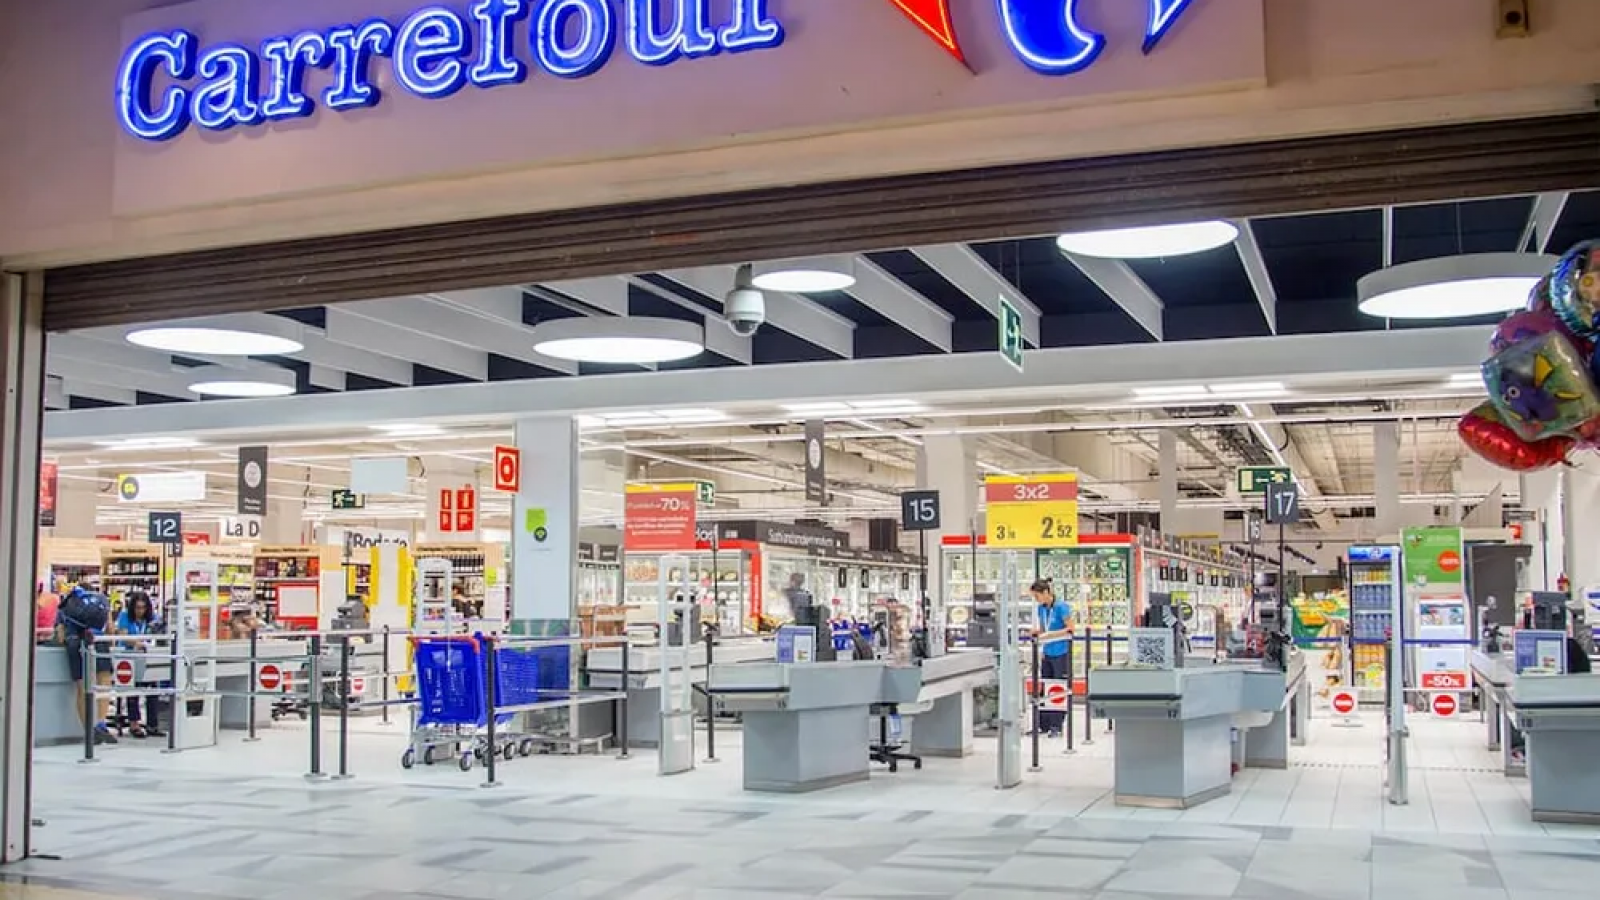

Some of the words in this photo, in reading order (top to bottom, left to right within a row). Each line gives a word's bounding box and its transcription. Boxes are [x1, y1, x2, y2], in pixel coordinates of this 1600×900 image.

[1013, 483, 1049, 499] 3x2
[909, 498, 936, 522] 15
[1274, 491, 1296, 515] 17
[153, 518, 177, 537] 12
[226, 519, 244, 537] La
[1041, 516, 1054, 539] 2
